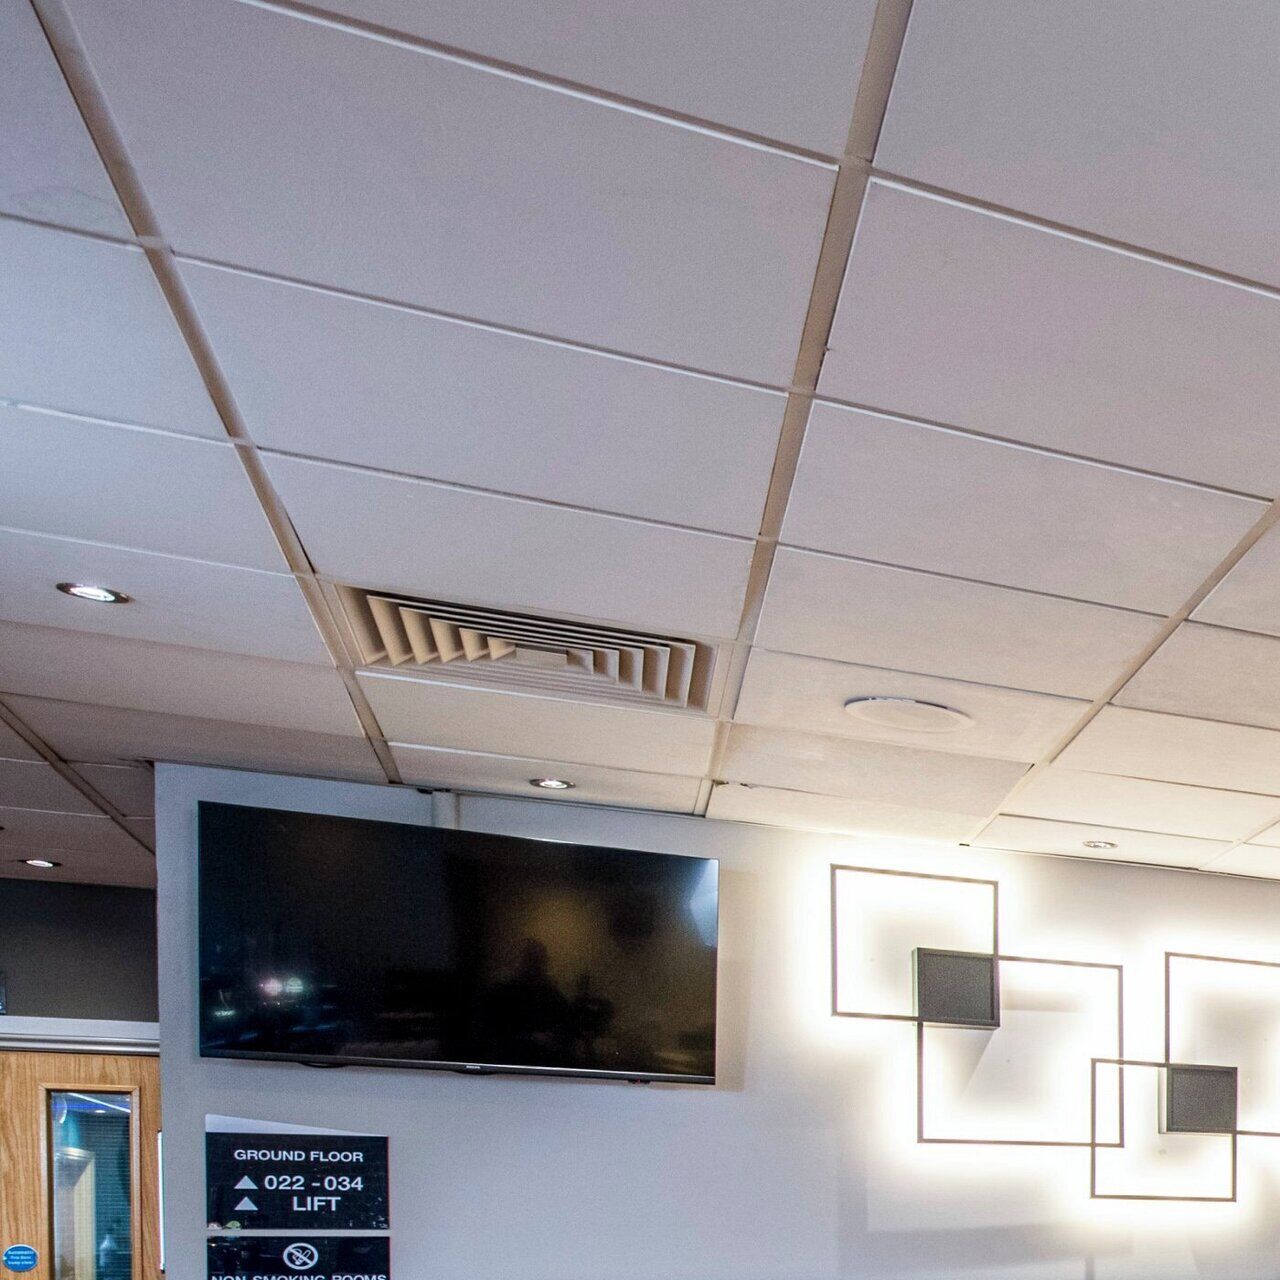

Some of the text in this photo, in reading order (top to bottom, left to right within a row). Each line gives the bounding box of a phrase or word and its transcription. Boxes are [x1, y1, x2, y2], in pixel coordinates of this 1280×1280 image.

[234, 1149, 364, 1163] GROUND FLOOR
[264, 1175, 305, 1190] 022
[292, 1196, 341, 1211] LIFT
